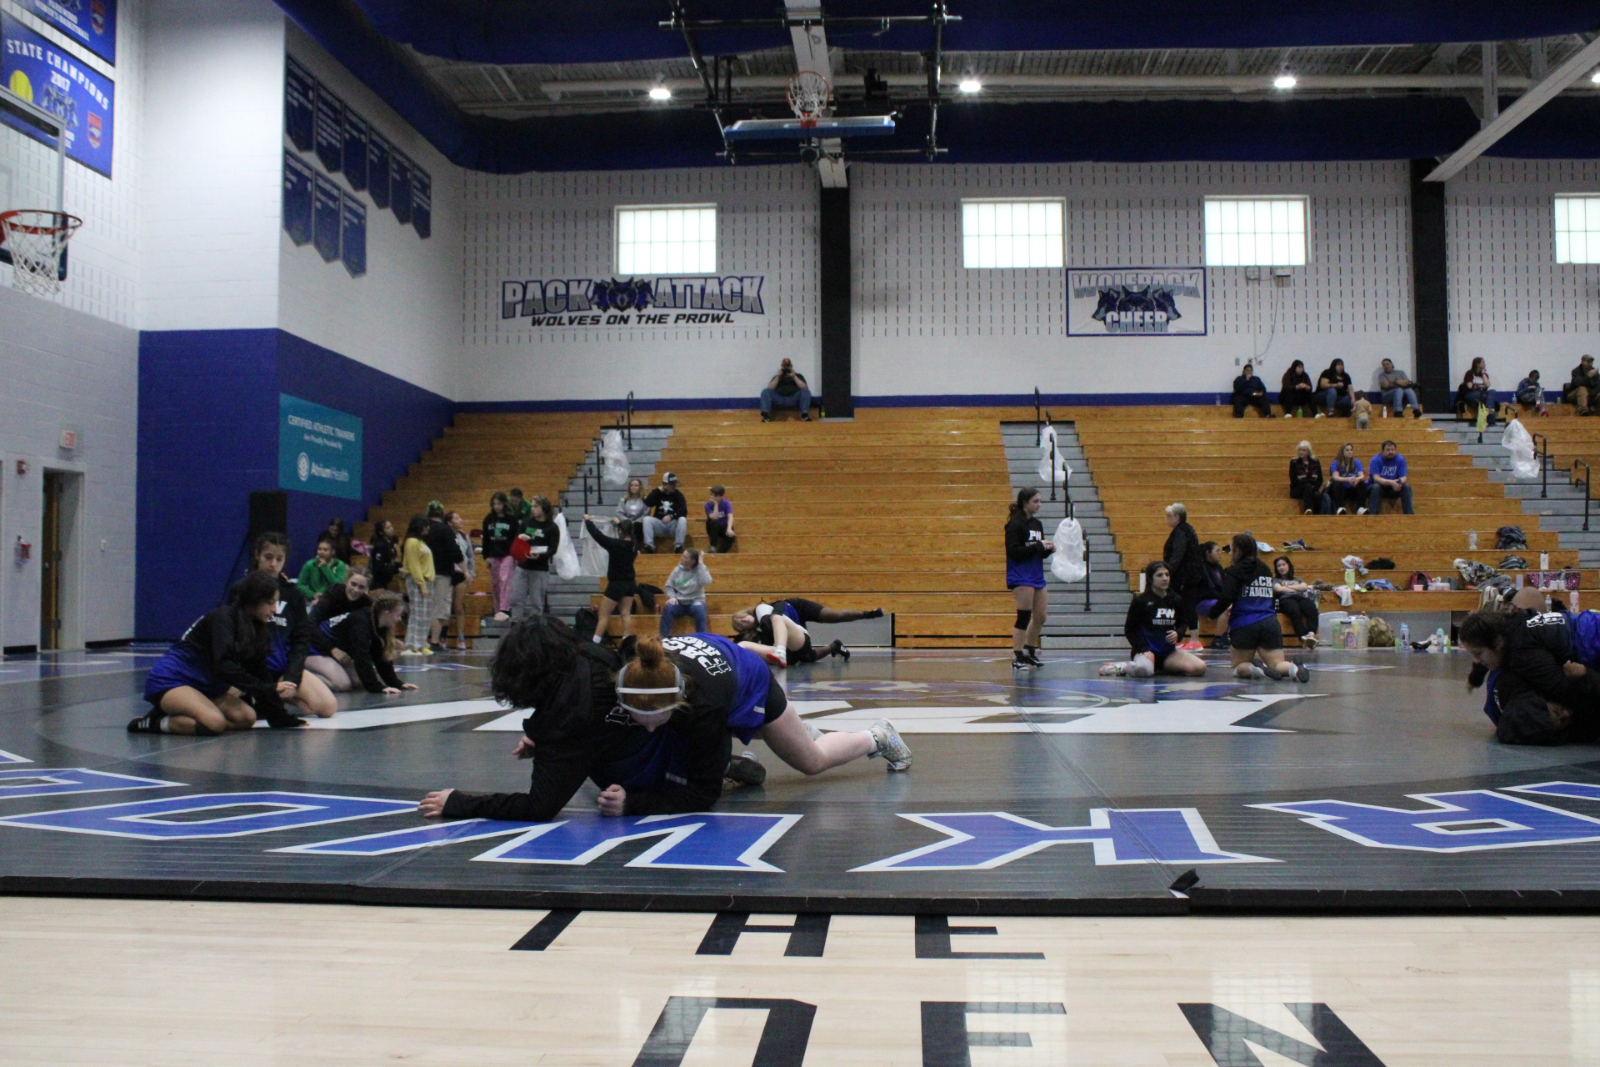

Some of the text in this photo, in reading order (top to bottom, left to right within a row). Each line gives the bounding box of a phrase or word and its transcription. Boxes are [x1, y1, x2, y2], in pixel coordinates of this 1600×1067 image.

[7, 39, 109, 110] STATE CHAMPIONS
[51, 70, 71, 92] 2017
[502, 275, 764, 319] PACK ATTACK
[531, 313, 735, 326] WOLVES ON THE PROWL
[1105, 310, 1169, 333] CHEER
[1250, 576, 1273, 587] ACK
[1155, 608, 1176, 619] PW
